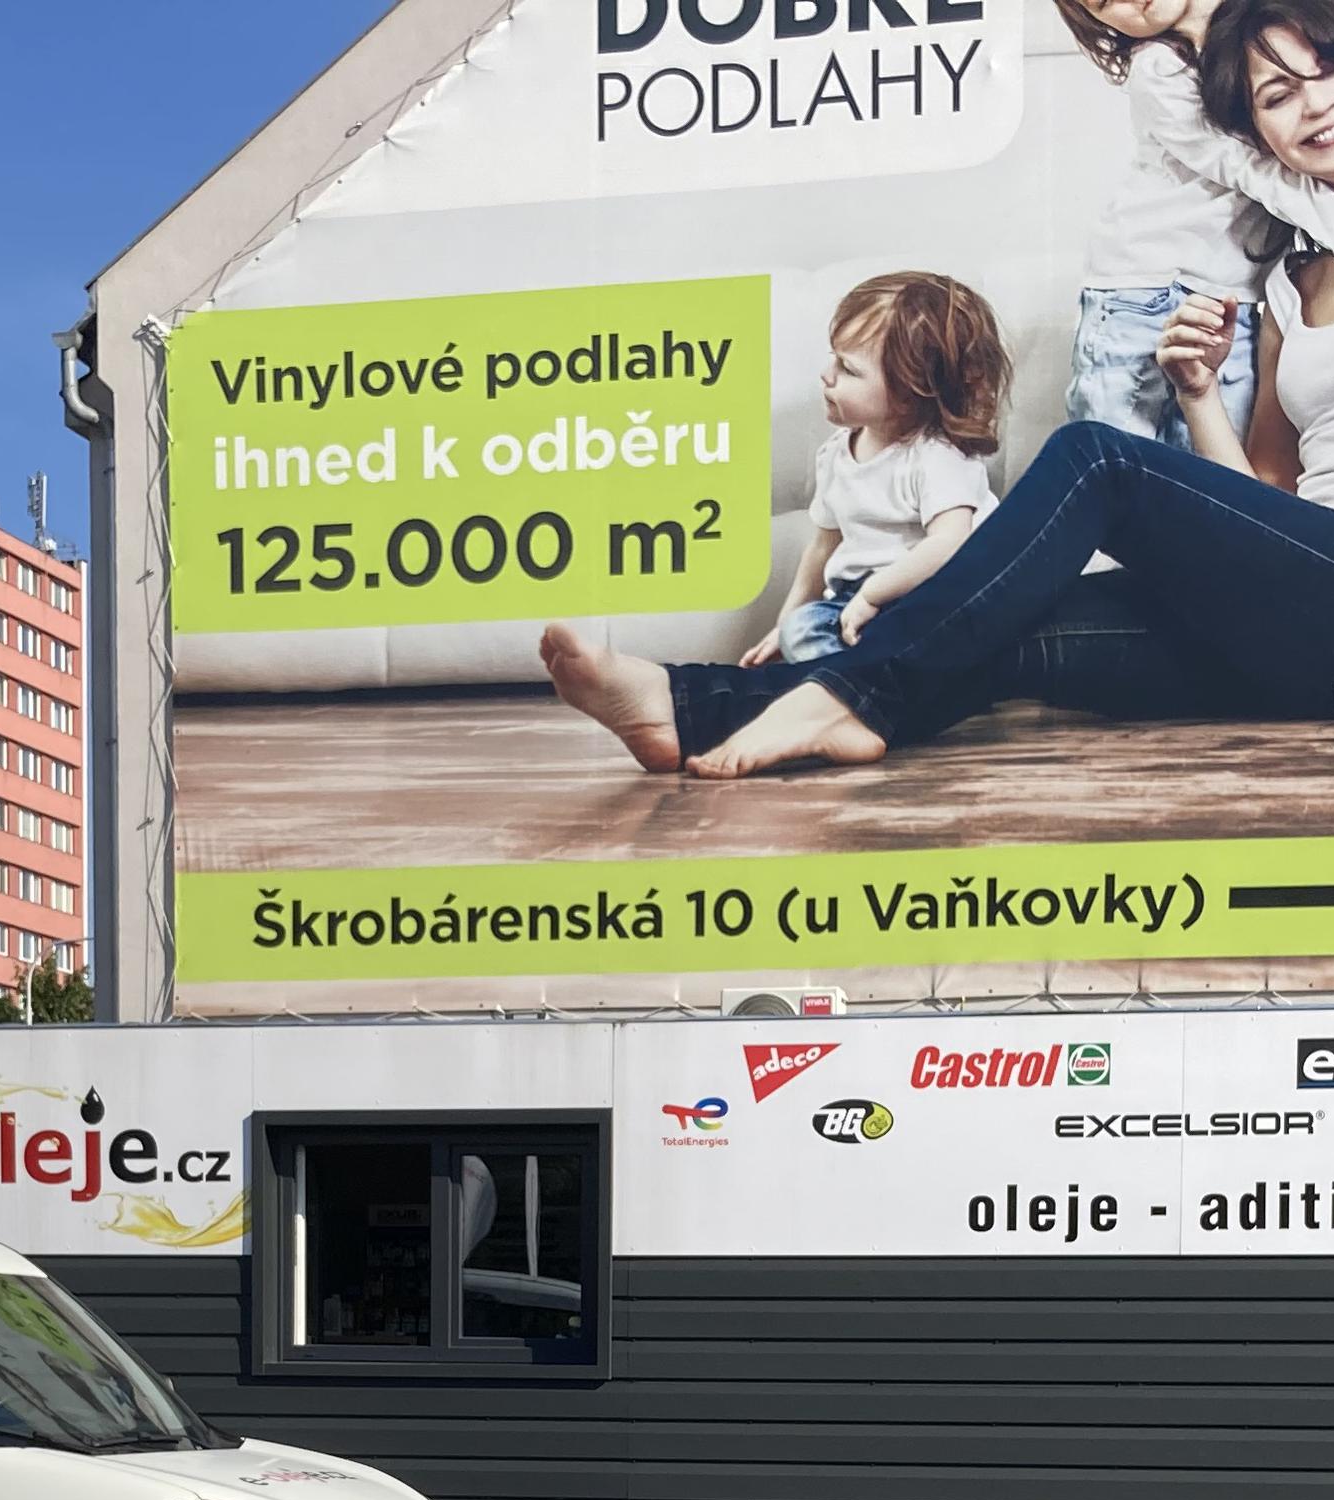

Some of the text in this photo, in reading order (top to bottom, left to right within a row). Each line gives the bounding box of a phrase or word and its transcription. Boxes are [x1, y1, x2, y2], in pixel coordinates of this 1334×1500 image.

[598, 0, 984, 54] DOB
[598, 39, 983, 142] PODLAHY
[210, 330, 733, 410] Vinylové podlahy
[214, 410, 730, 489] ihned k odběru
[216, 511, 574, 595] 125.000
[253, 888, 664, 948] Škrobárenská
[686, 889, 754, 937] 10
[777, 887, 838, 943] (u
[862, 873, 1205, 932] Vaňkovky)
[752, 1046, 822, 1081] adeco
[910, 1044, 1107, 1089] Castrol Castrol
[662, 1136, 730, 1148] TotalEnergies
[817, 1107, 867, 1138] BG
[968, 1183, 1119, 1243] oleje
[1150, 1205, 1168, 1217] -
